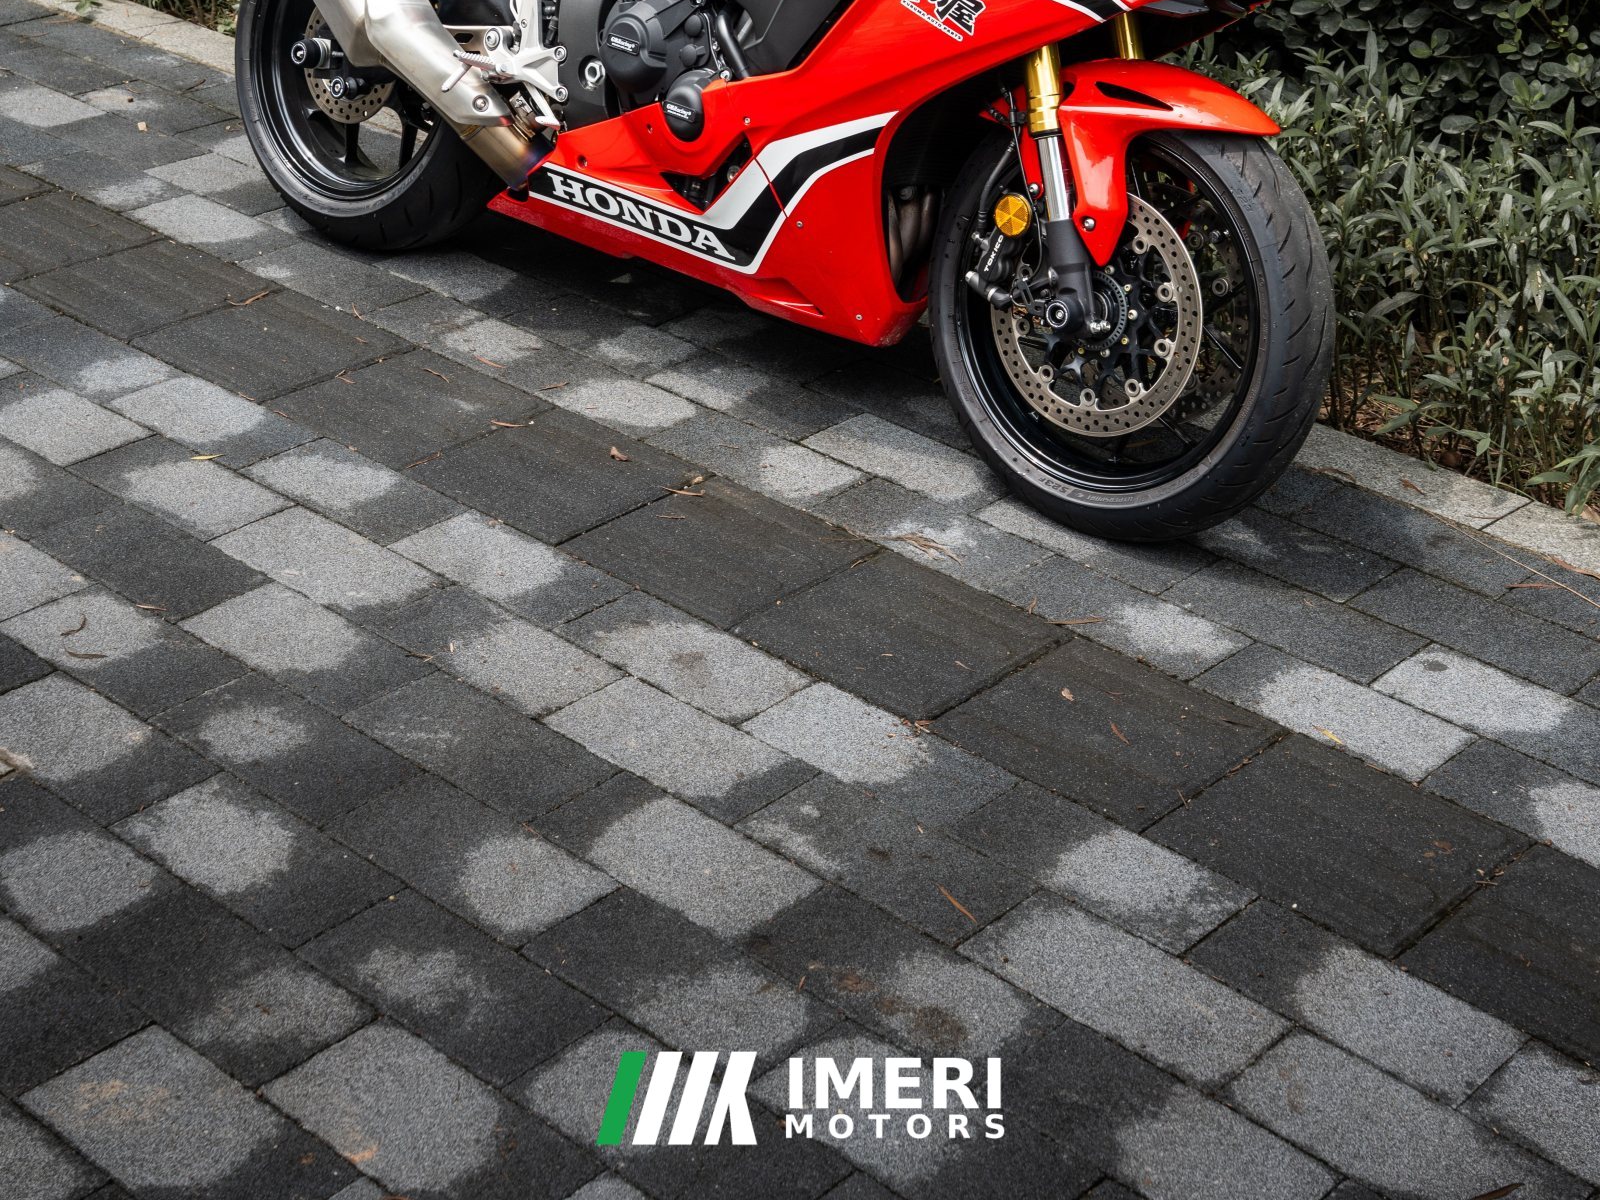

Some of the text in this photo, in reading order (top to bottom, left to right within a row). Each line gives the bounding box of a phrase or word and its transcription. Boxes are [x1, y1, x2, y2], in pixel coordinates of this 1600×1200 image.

[926, 16, 943, 28] AUTO
[943, 26, 962, 40] PARTS
[547, 171, 736, 261] HONDA
[983, 234, 1004, 272] TOKICO
